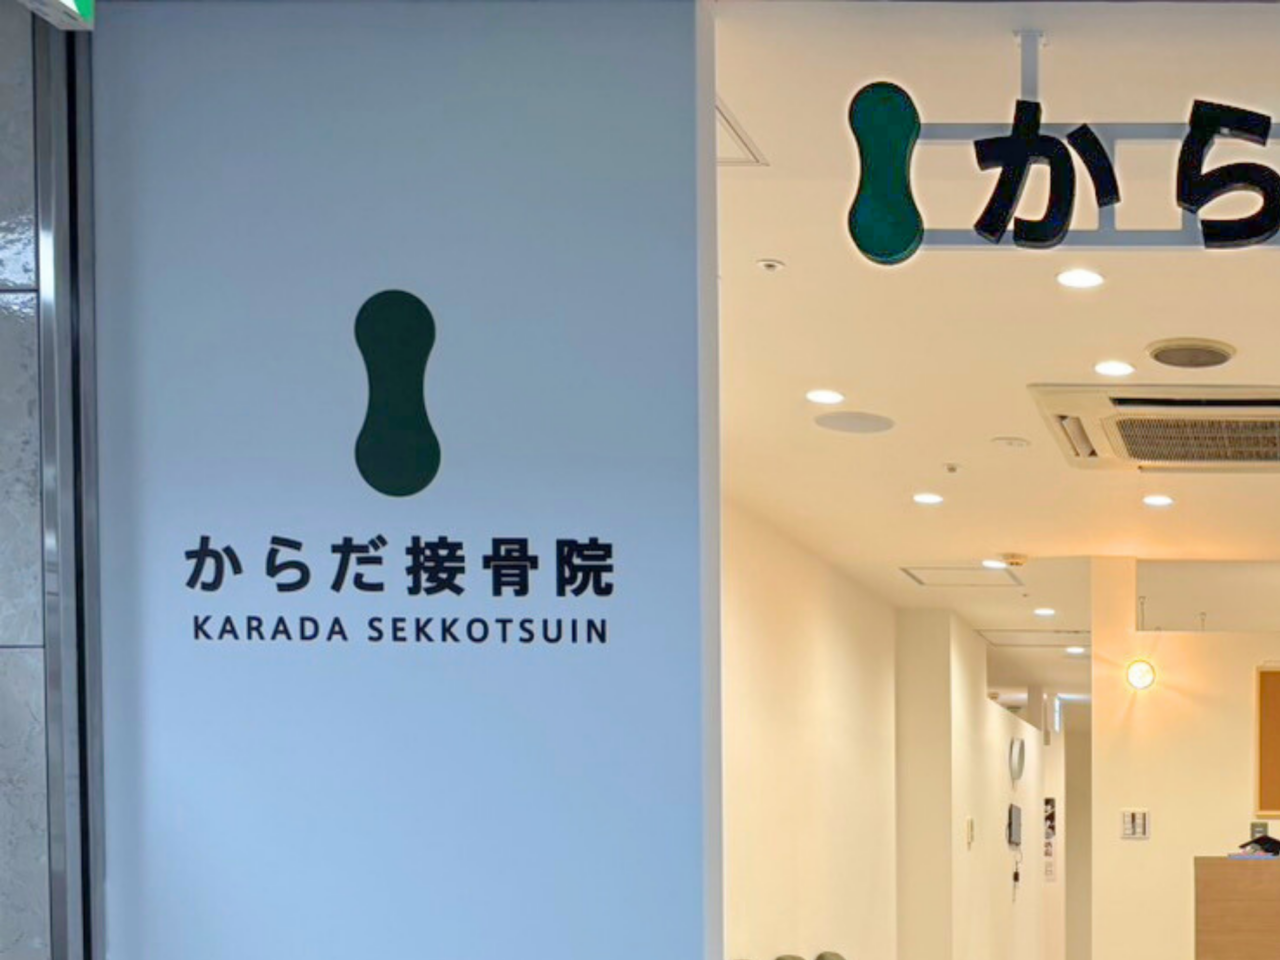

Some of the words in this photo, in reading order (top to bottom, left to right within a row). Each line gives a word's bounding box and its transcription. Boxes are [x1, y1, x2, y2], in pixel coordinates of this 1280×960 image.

[184, 534, 614, 597] からだ接骨院
[193, 615, 348, 641] KARADA
[367, 616, 607, 643] SEKKOTSUIN
